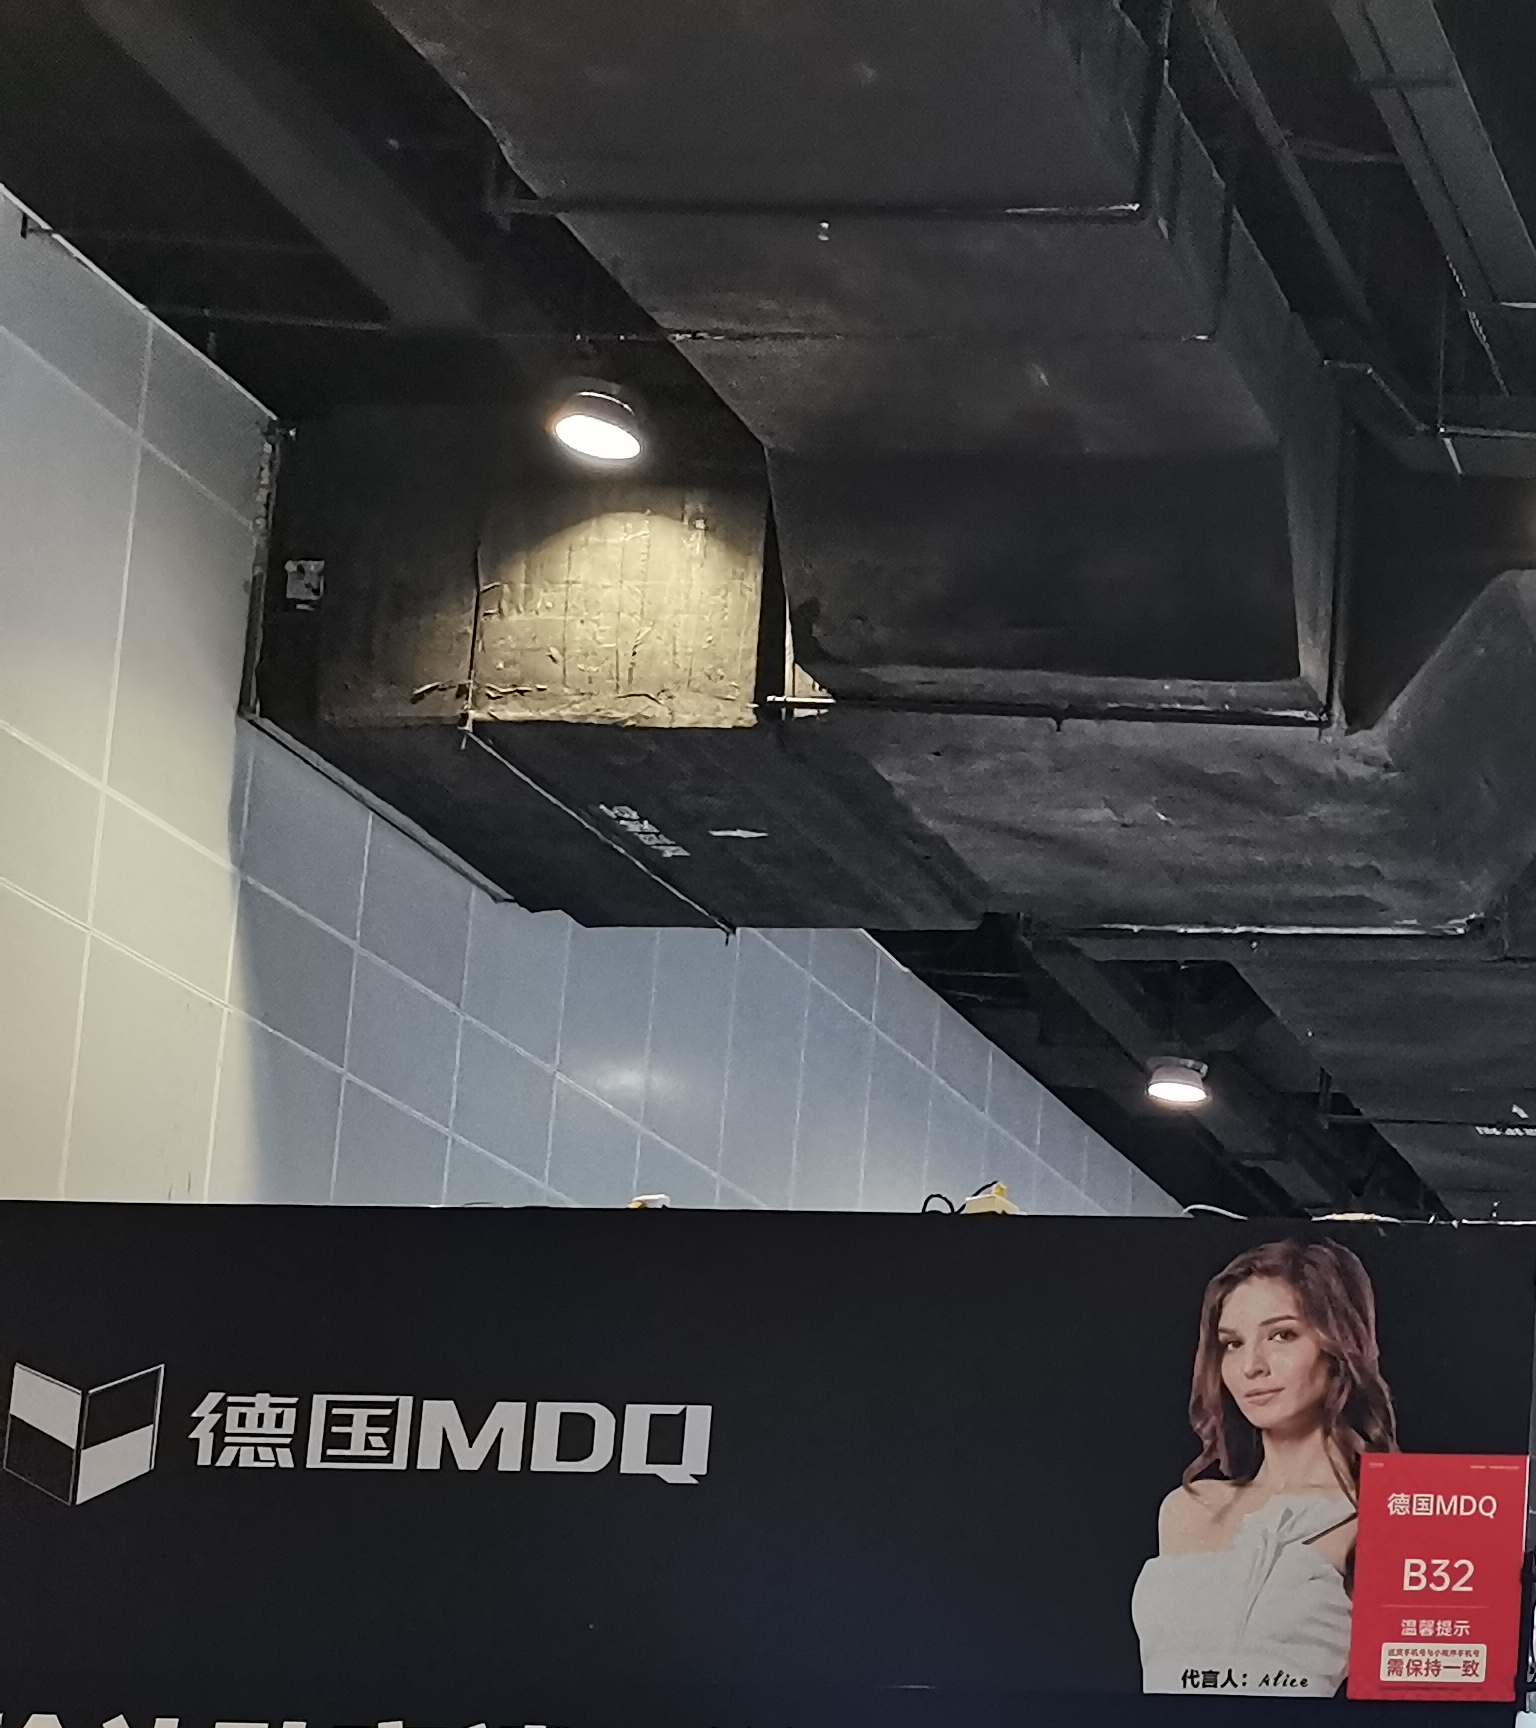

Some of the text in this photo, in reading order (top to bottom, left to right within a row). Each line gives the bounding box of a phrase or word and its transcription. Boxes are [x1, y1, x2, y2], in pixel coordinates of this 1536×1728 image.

[188, 1391, 714, 1485] 德国MDQ
[1387, 1493, 1498, 1519] 德国MDQ
[1403, 1558, 1475, 1592] B32
[1400, 1619, 1471, 1638] 温馨提示
[1180, 1669, 1310, 1690] 代言人： Alice
[1386, 1659, 1480, 1678] 需保持一致
